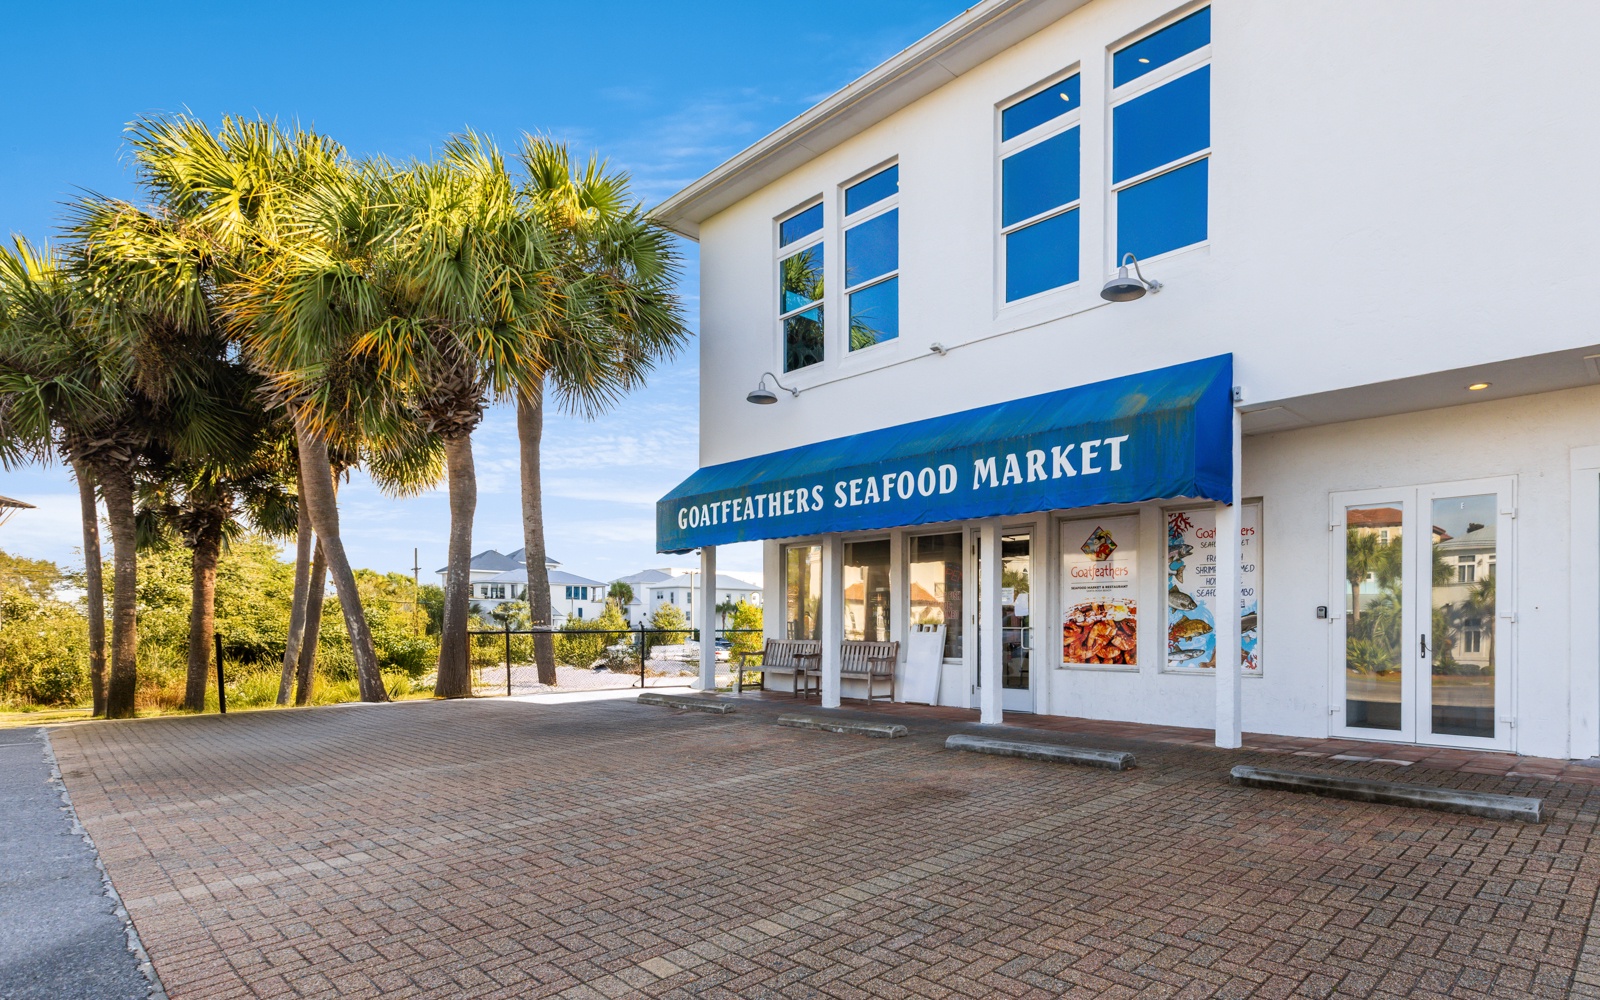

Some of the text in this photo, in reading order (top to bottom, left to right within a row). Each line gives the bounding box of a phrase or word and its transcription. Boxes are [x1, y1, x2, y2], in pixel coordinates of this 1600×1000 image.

[678, 433, 1130, 530] GOATFEATHERS SEAFOOD MARKET
[1071, 562, 1129, 581] Goatfeathers
